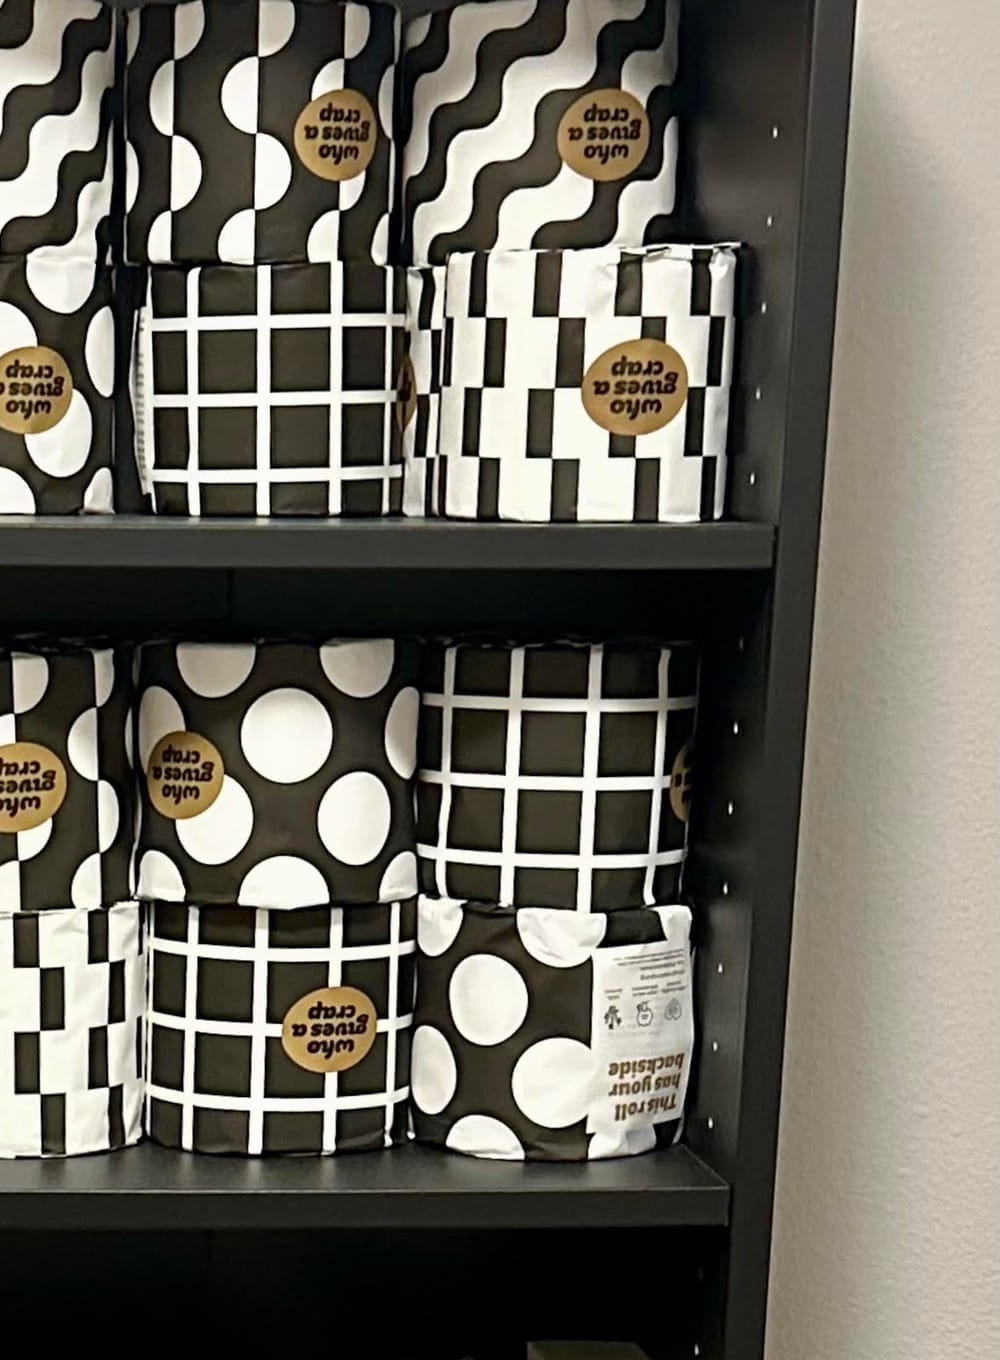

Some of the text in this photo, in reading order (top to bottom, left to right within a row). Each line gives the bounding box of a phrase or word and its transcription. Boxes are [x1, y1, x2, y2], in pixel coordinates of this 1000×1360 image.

[5, 359, 54, 379] crap
[611, 355, 664, 376] crap
[8, 376, 65, 397] gives
[592, 371, 679, 395] gives a
[5, 400, 52, 420] who
[610, 399, 662, 421] who
[308, 1001, 356, 1020] crap
[292, 1016, 368, 1037] gives a
[307, 1037, 355, 1060] who
[608, 1052, 685, 1079] backside
